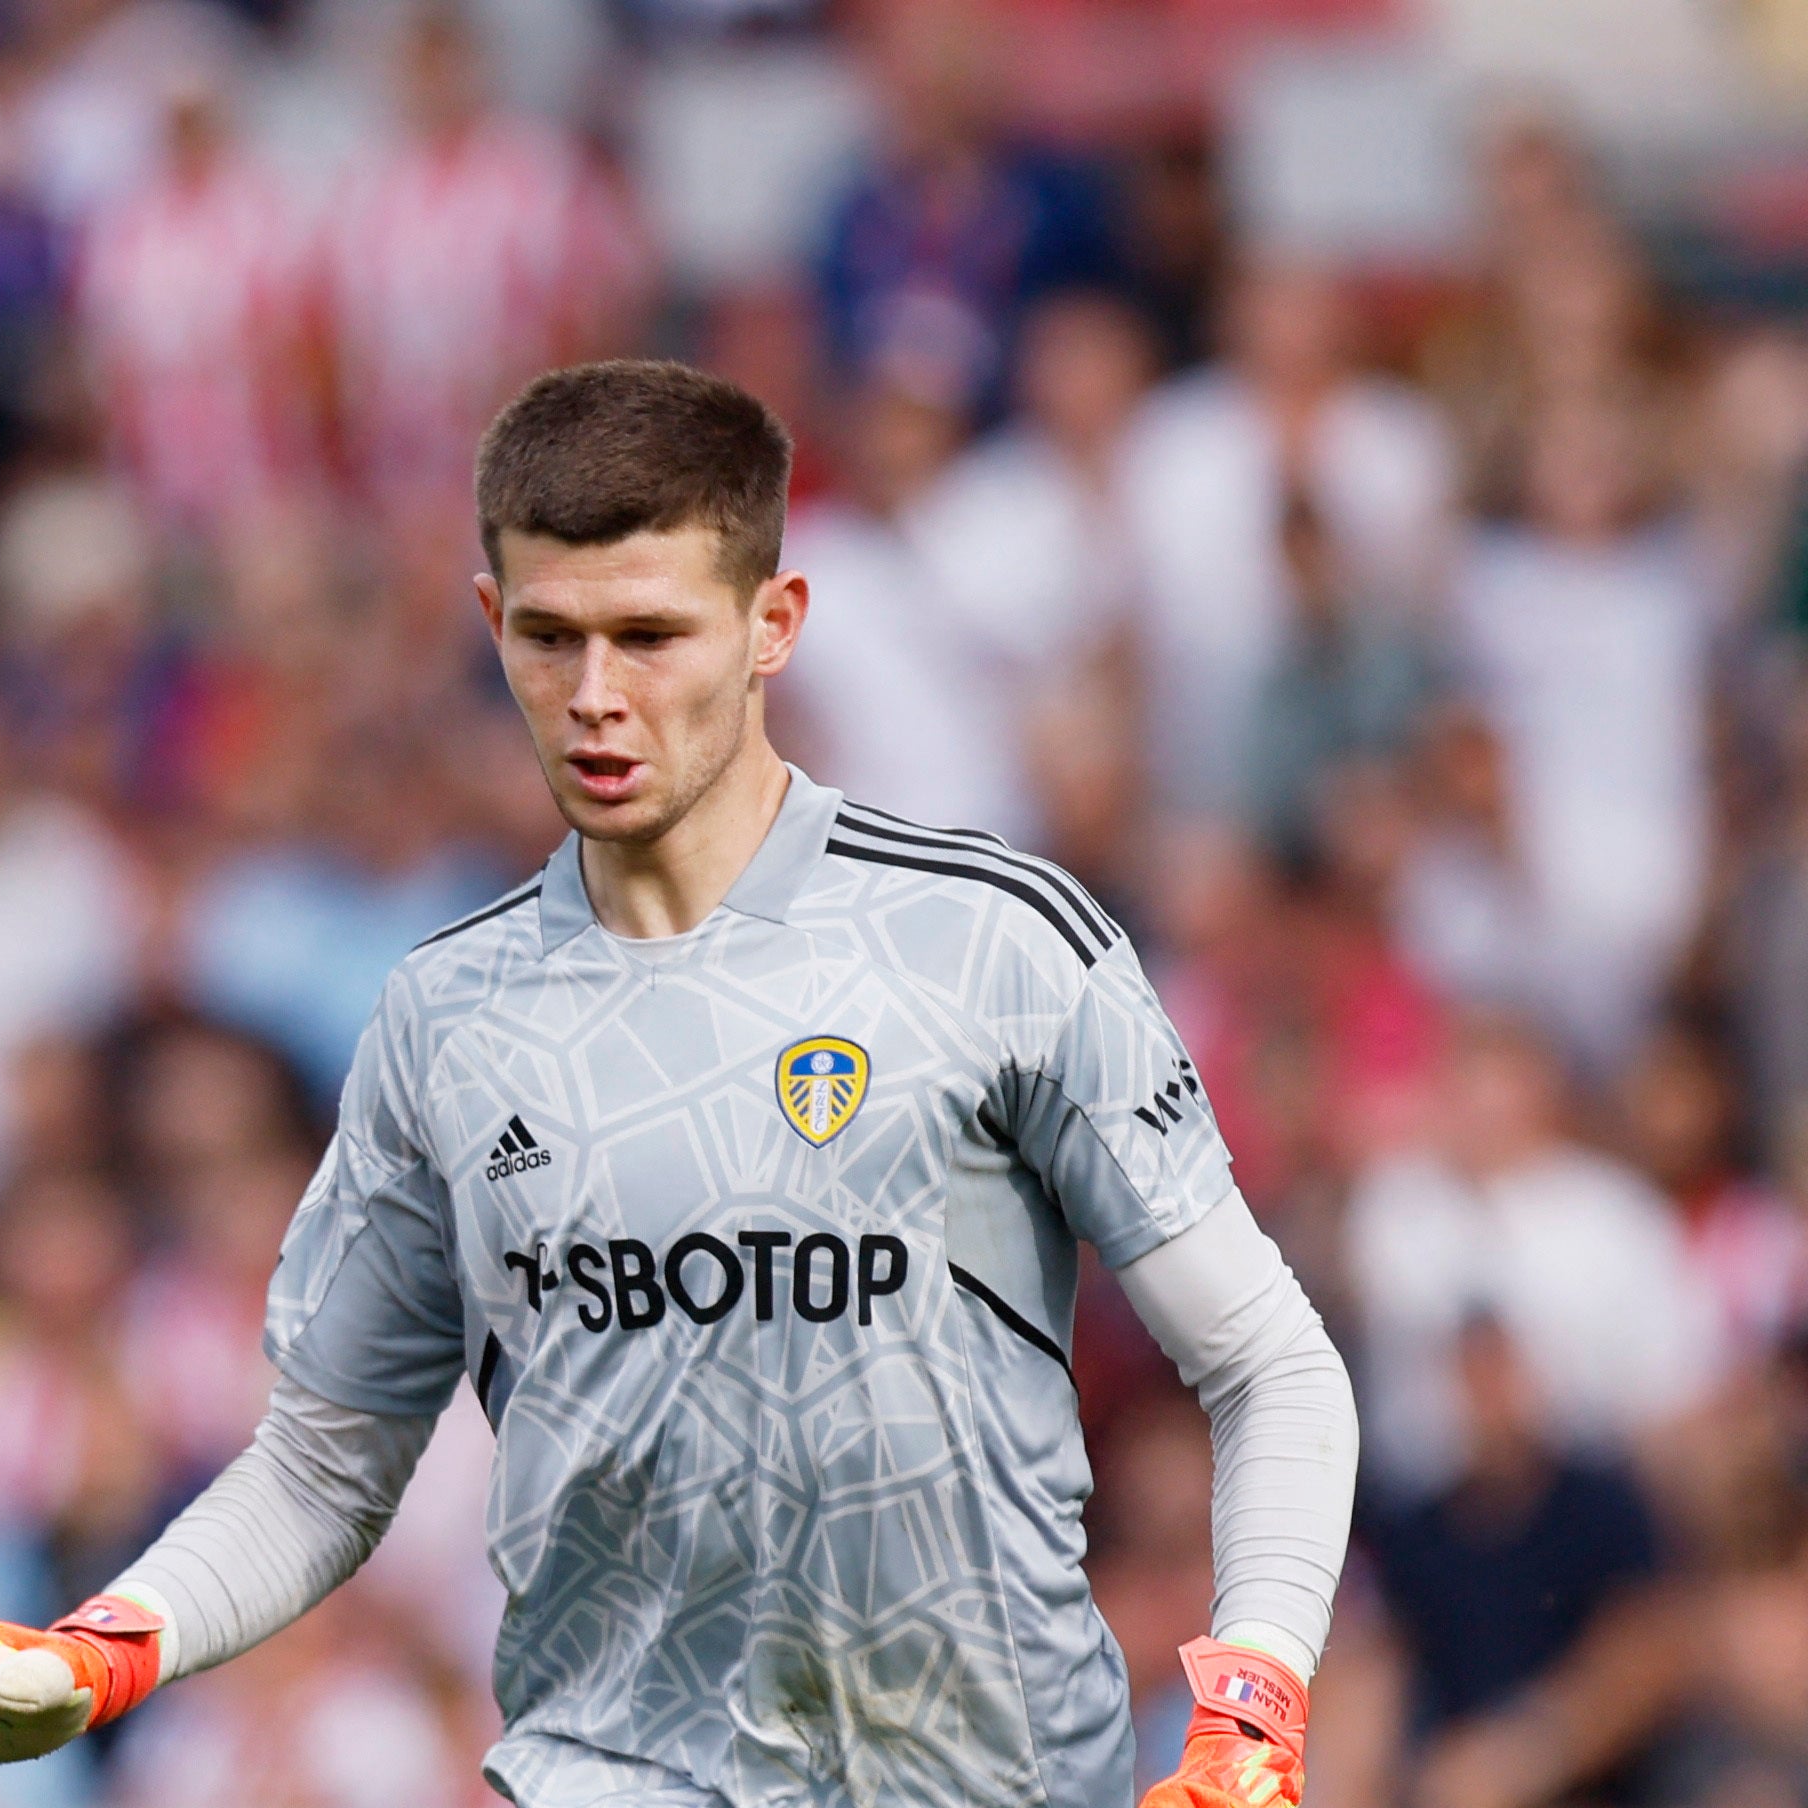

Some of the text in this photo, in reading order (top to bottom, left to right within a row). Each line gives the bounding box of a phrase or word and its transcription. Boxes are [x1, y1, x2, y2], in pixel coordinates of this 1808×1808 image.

[486, 1149, 552, 1182] adidas
[567, 1231, 909, 1333] SBOTOP
[1236, 1667, 1291, 1708] MESLIER
